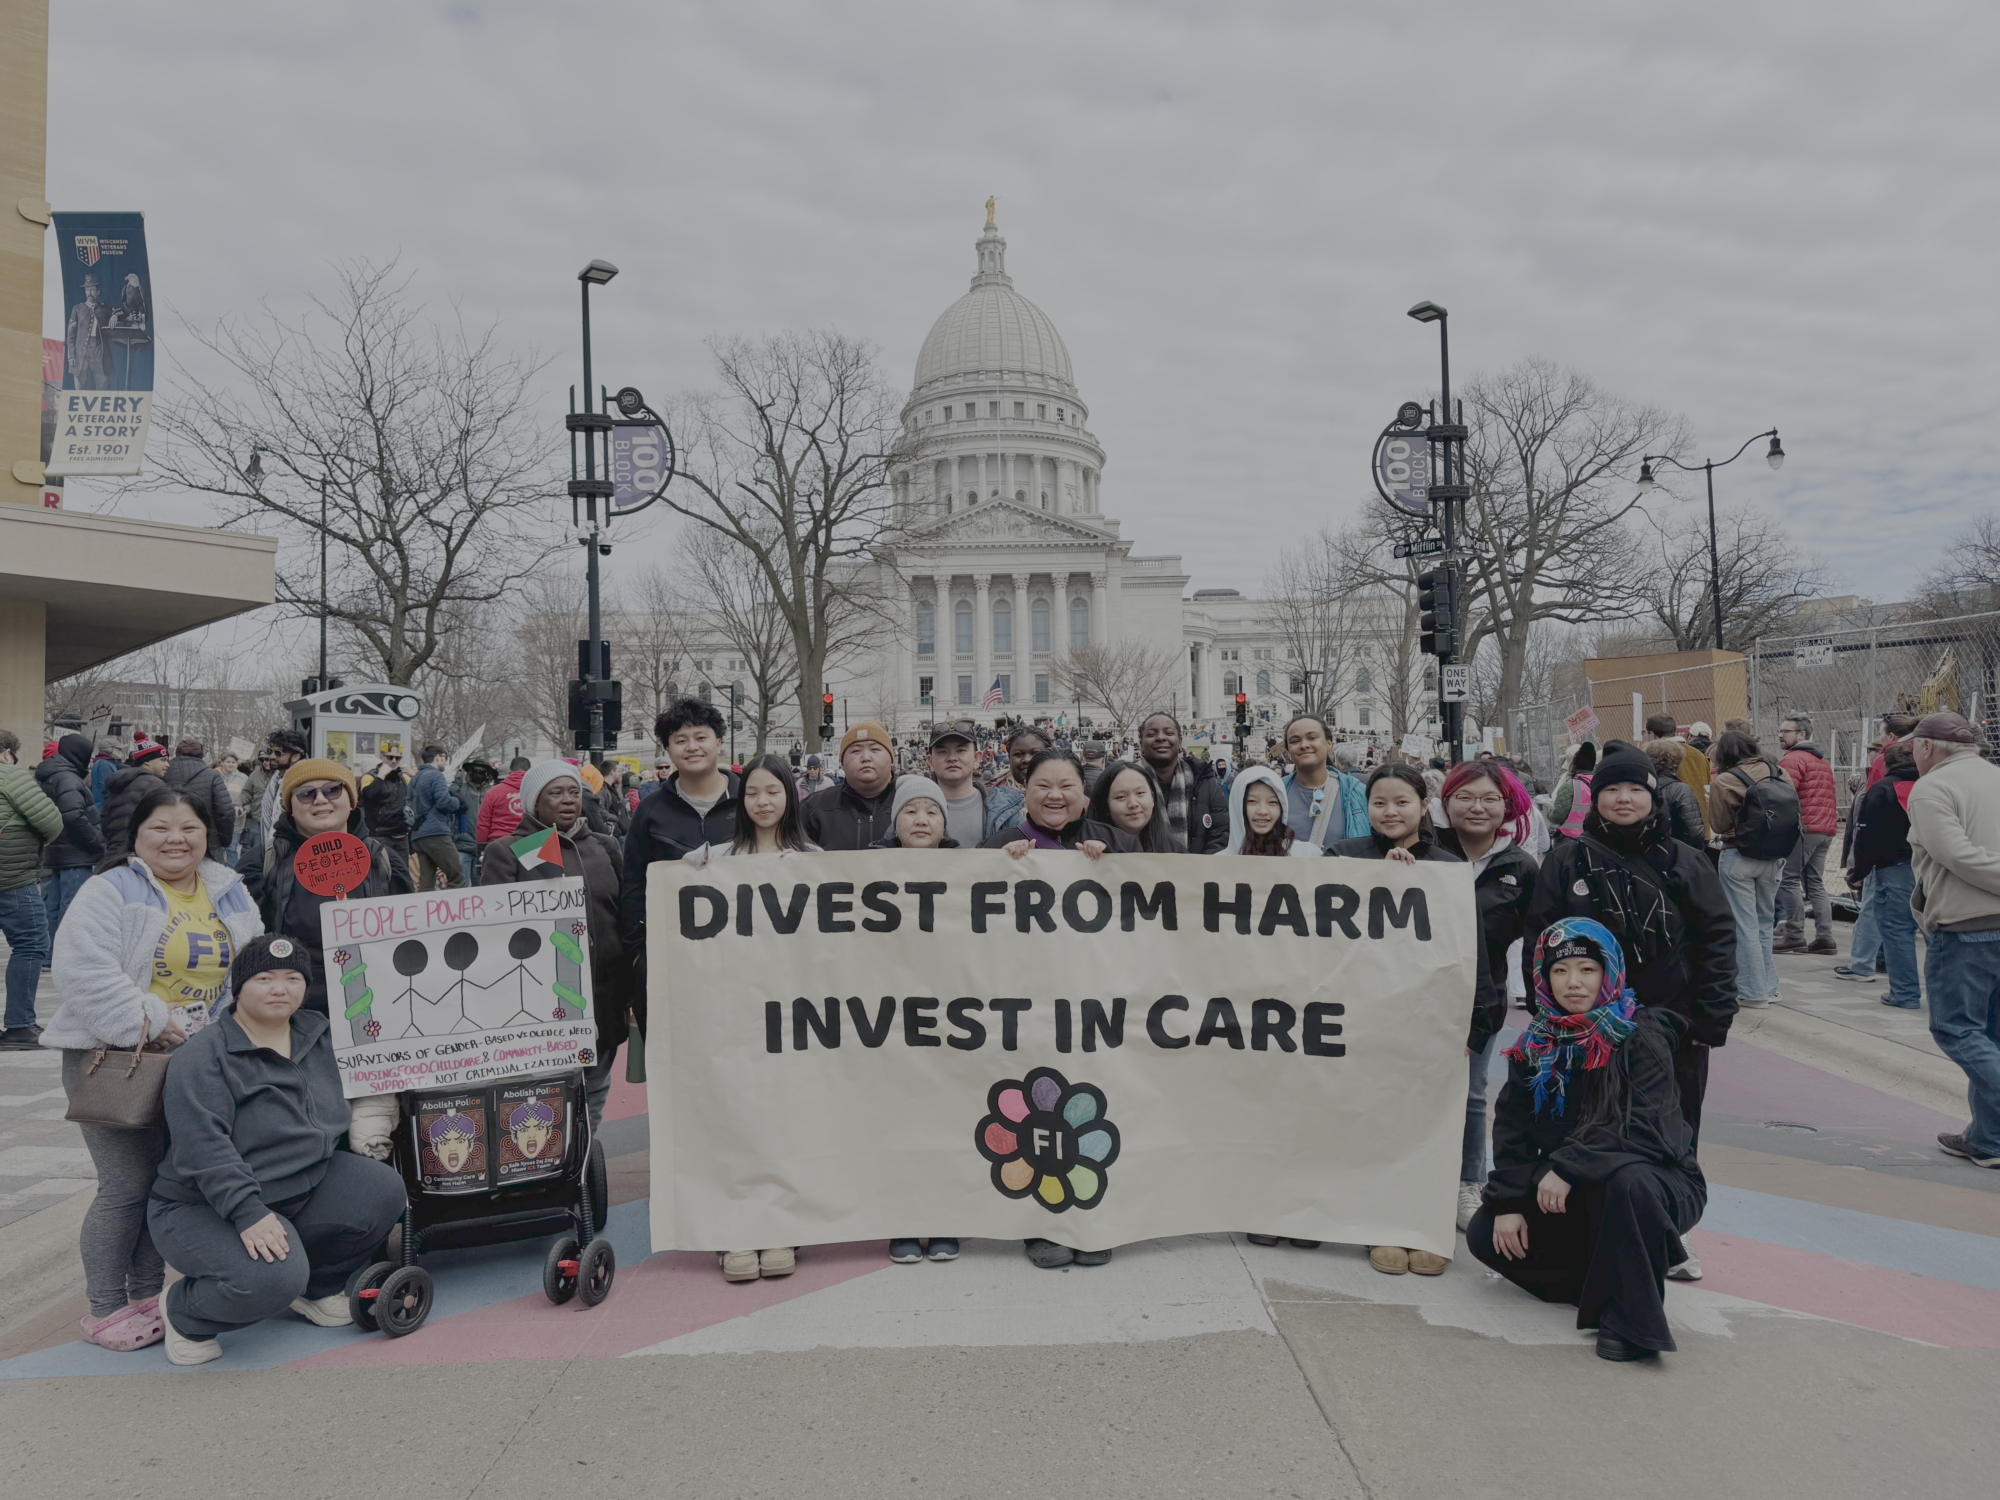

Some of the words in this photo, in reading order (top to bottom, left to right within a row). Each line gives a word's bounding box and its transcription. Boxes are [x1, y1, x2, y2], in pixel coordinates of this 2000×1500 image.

[76, 237, 97, 245] WVM
[68, 395, 144, 413] EVERY
[64, 425, 77, 437] A
[83, 425, 141, 438] STORY
[68, 414, 127, 424] VETERAN
[130, 415, 143, 424] IS
[68, 444, 91, 455] Est.
[96, 444, 130, 455] 1901
[631, 430, 660, 491] 100
[615, 440, 632, 492] BLOCK
[1386, 440, 1411, 496] 100
[1412, 450, 1426, 498] BLOCK
[1411, 540, 1435, 554] Mifflin
[1446, 668, 1466, 678] ONE
[1446, 678, 1467, 688] WAY
[311, 838, 343, 856] BUILD
[296, 846, 366, 875] PEOPLE
[315, 873, 329, 884] NOT
[332, 904, 418, 942] PEOPLE
[426, 895, 486, 928] POWER
[508, 888, 585, 916] PRISONS
[678, 880, 947, 940] DIVEST
[969, 879, 1178, 934] FROM
[1203, 881, 1432, 942] HARM
[153, 911, 191, 977] Community
[186, 931, 230, 969] FI
[764, 995, 1033, 1053] INVEST
[1054, 997, 1127, 1054] IN
[1146, 994, 1346, 1057] CARE
[337, 1051, 411, 1070] SURVIVORS
[415, 1048, 431, 1059] OF
[435, 1031, 515, 1056] GENDER-BASED
[516, 1028, 566, 1040] VIOLENCE
[569, 1026, 592, 1036] NEED
[493, 1039, 578, 1062] COMMUNITY-BASED
[435, 1071, 459, 1085] NOT
[465, 1053, 577, 1081] CRIMINALIZATION!
[422, 1100, 453, 1111] Abolish
[455, 1097, 481, 1107] Police
[503, 1088, 534, 1099] Abolish
[536, 1086, 561, 1096] Police
[1033, 1128, 1063, 1160] FI
